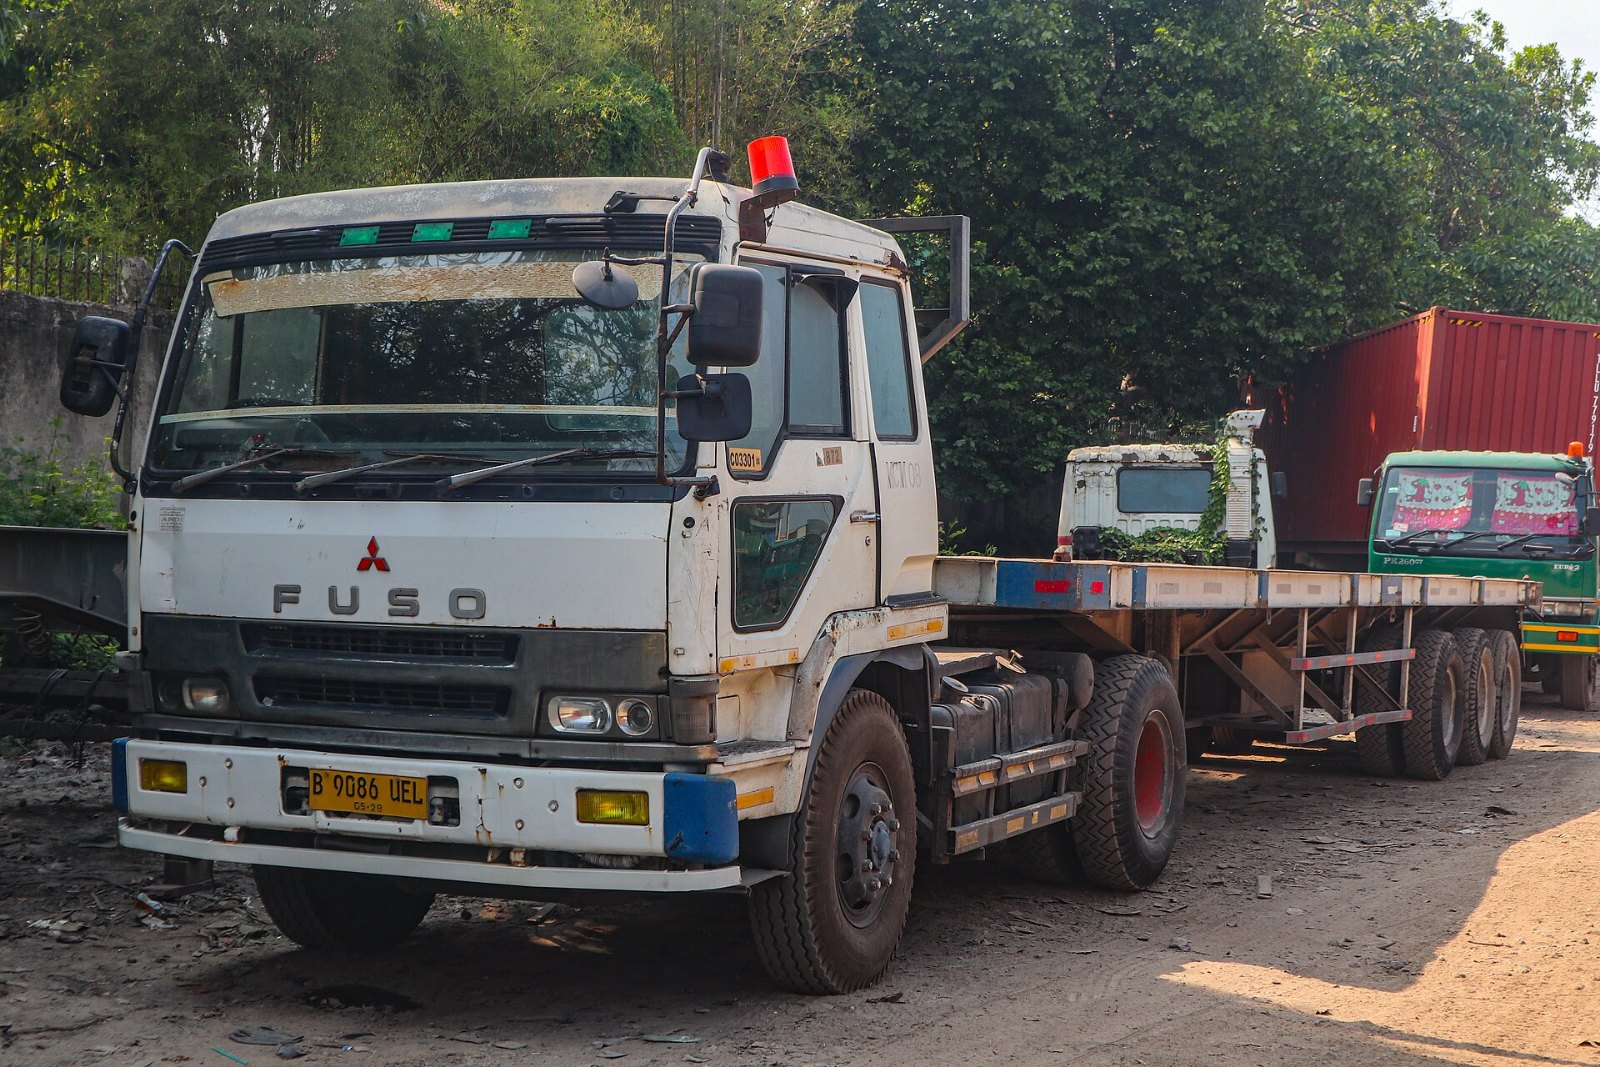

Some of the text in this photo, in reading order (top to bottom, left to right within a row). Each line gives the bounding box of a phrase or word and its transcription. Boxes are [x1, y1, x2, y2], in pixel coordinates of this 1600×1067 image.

[273, 584, 486, 619] FUSO
[312, 772, 424, 804] B 9086 UEL
